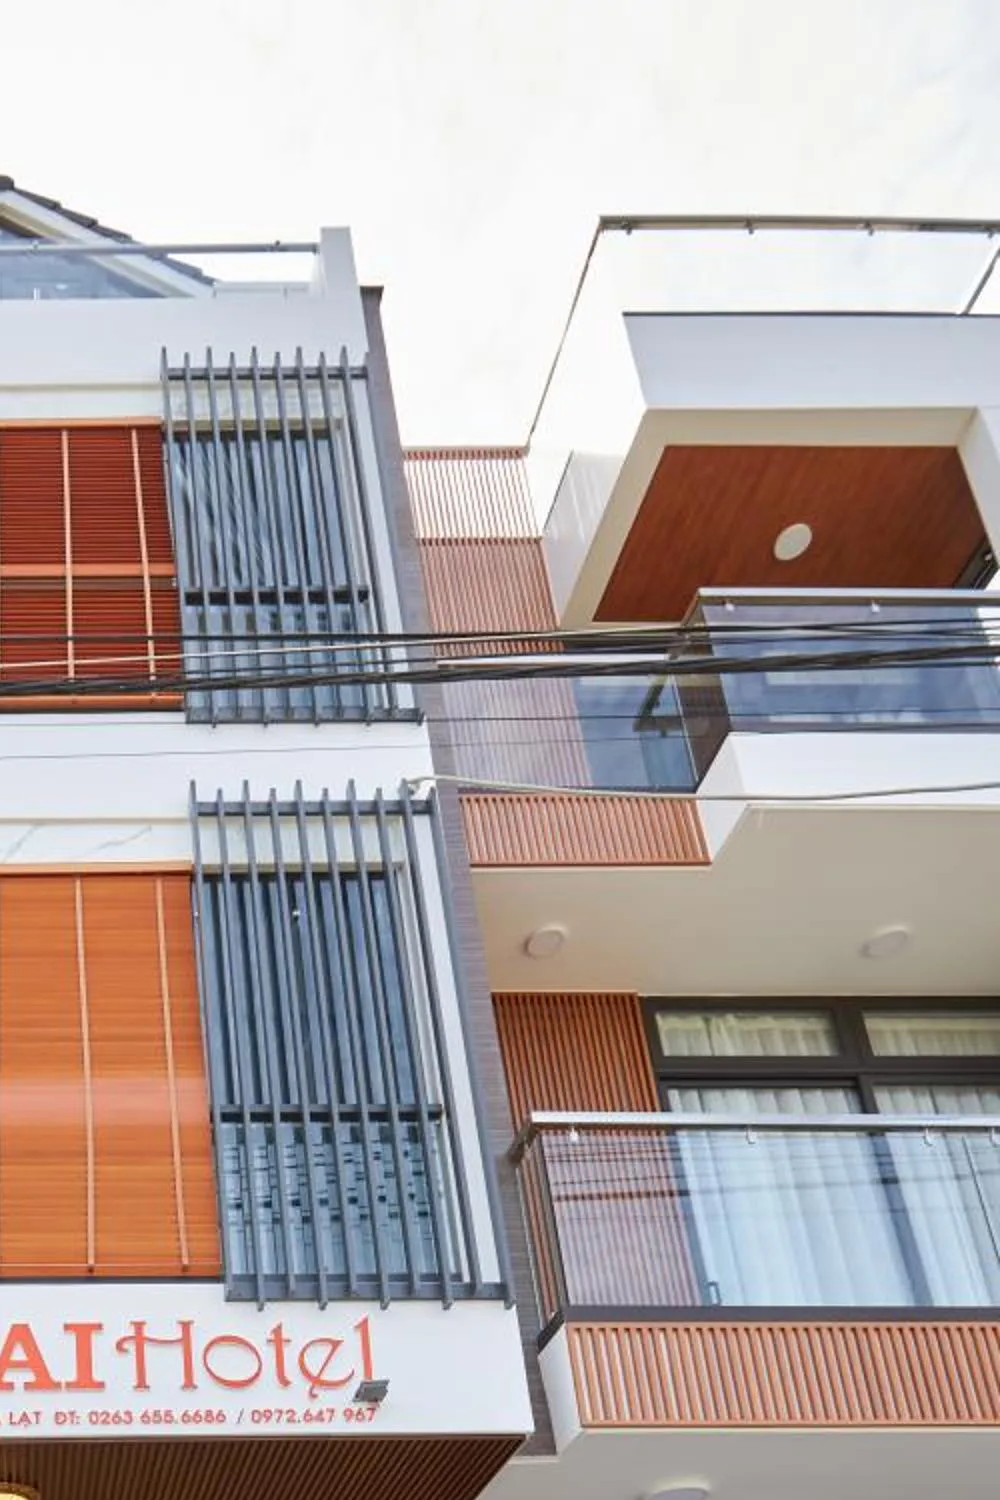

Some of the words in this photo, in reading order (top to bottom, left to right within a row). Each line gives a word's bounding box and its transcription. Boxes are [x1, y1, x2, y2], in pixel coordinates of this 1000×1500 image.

[115, 1314, 376, 1399] Hotel
[9, 1410, 43, 1427] LẠT
[88, 1409, 133, 1425] 0263
[343, 1405, 378, 1422] 967
